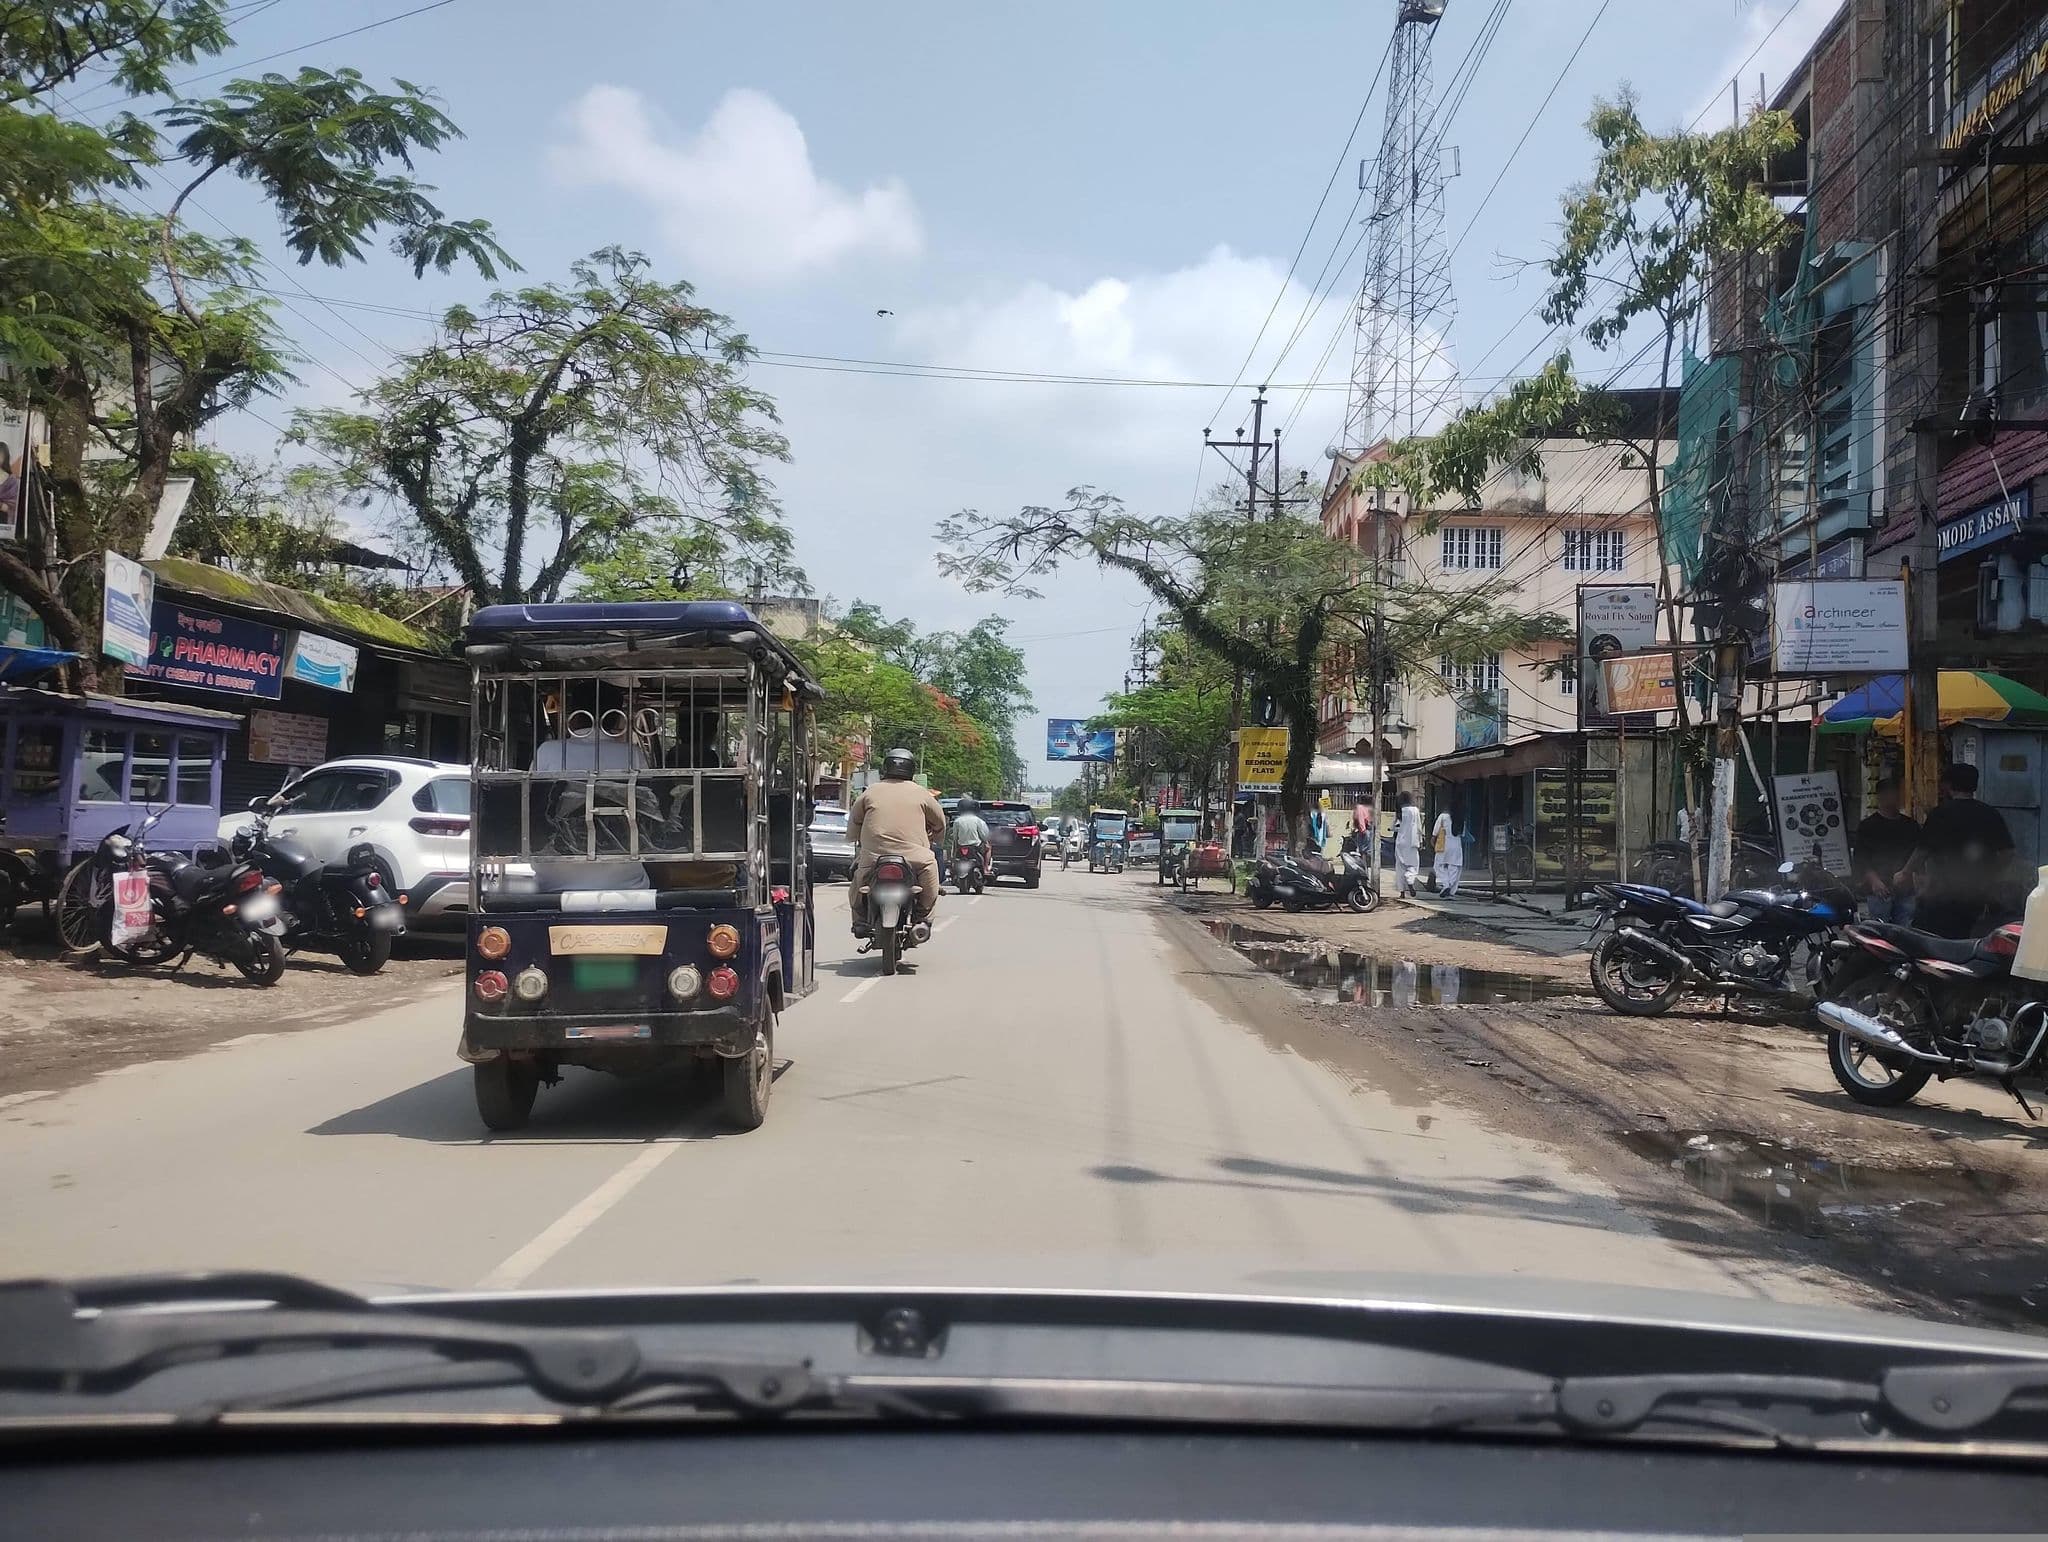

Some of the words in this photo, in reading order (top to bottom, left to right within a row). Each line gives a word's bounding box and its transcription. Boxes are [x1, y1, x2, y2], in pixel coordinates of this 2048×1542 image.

[1979, 498, 2020, 535] ASSAM
[1585, 612, 1609, 621] Royal
[1628, 612, 1653, 620] Salon
[1804, 605, 1876, 618] archineer
[175, 636, 280, 677] PHARMACY
